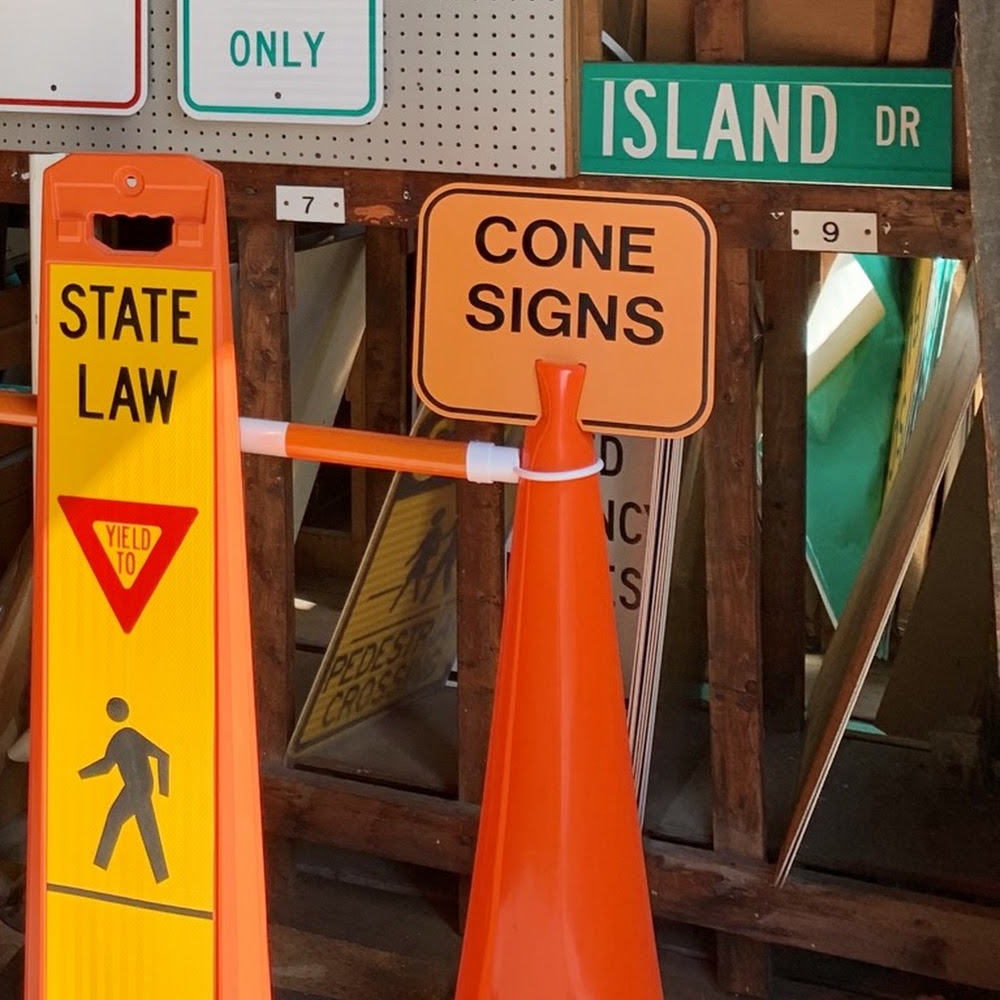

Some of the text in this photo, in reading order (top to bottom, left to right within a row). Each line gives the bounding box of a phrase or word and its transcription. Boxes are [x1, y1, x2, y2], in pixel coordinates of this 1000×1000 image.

[229, 30, 326, 68] ONLY
[602, 79, 921, 164] ISLAND DR
[302, 195, 314, 214] 7
[475, 215, 656, 275] CONE
[822, 221, 839, 243] 9
[59, 282, 199, 346] STATE
[465, 282, 665, 346] SIGNS
[77, 363, 177, 425] LAW
[105, 524, 151, 552] YIELD
[116, 549, 136, 576] TO
